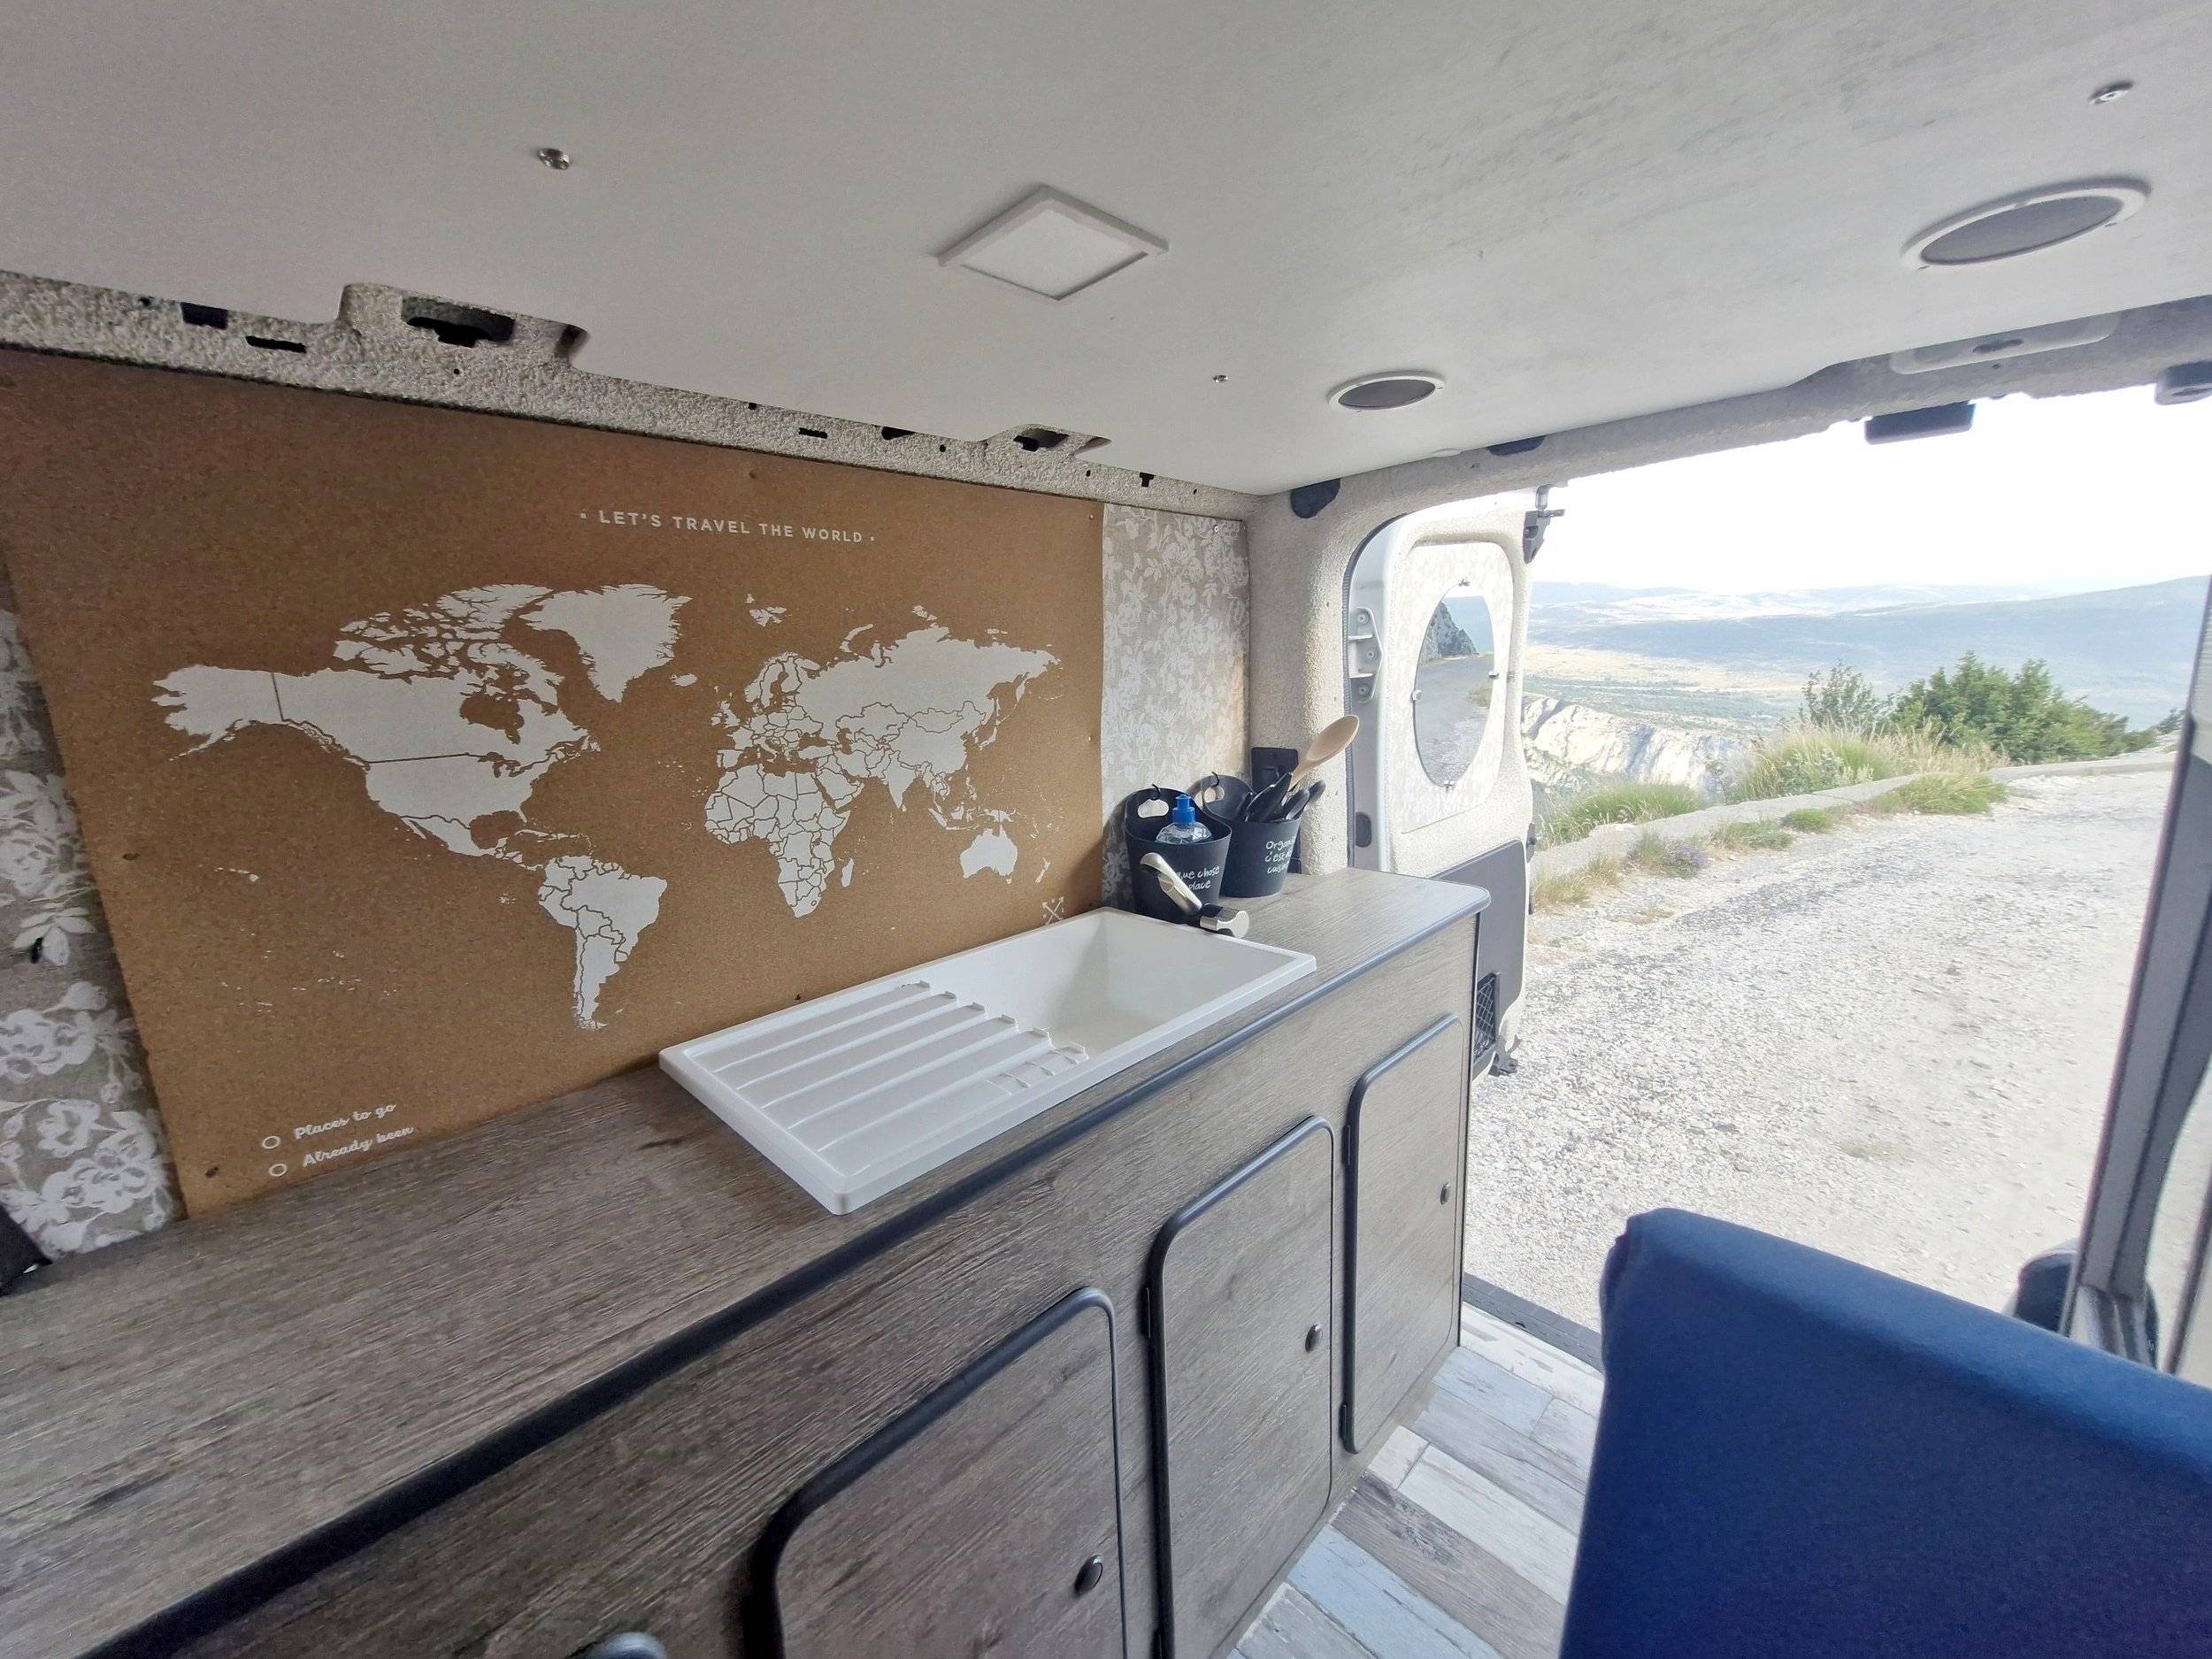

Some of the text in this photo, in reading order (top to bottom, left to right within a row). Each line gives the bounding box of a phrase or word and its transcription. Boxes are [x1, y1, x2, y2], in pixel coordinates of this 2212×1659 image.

[598, 510, 863, 543] LET'S TRAVEL THE WORLD
[294, 1103, 397, 1140] Places to go
[303, 1126, 414, 1168] Already been
